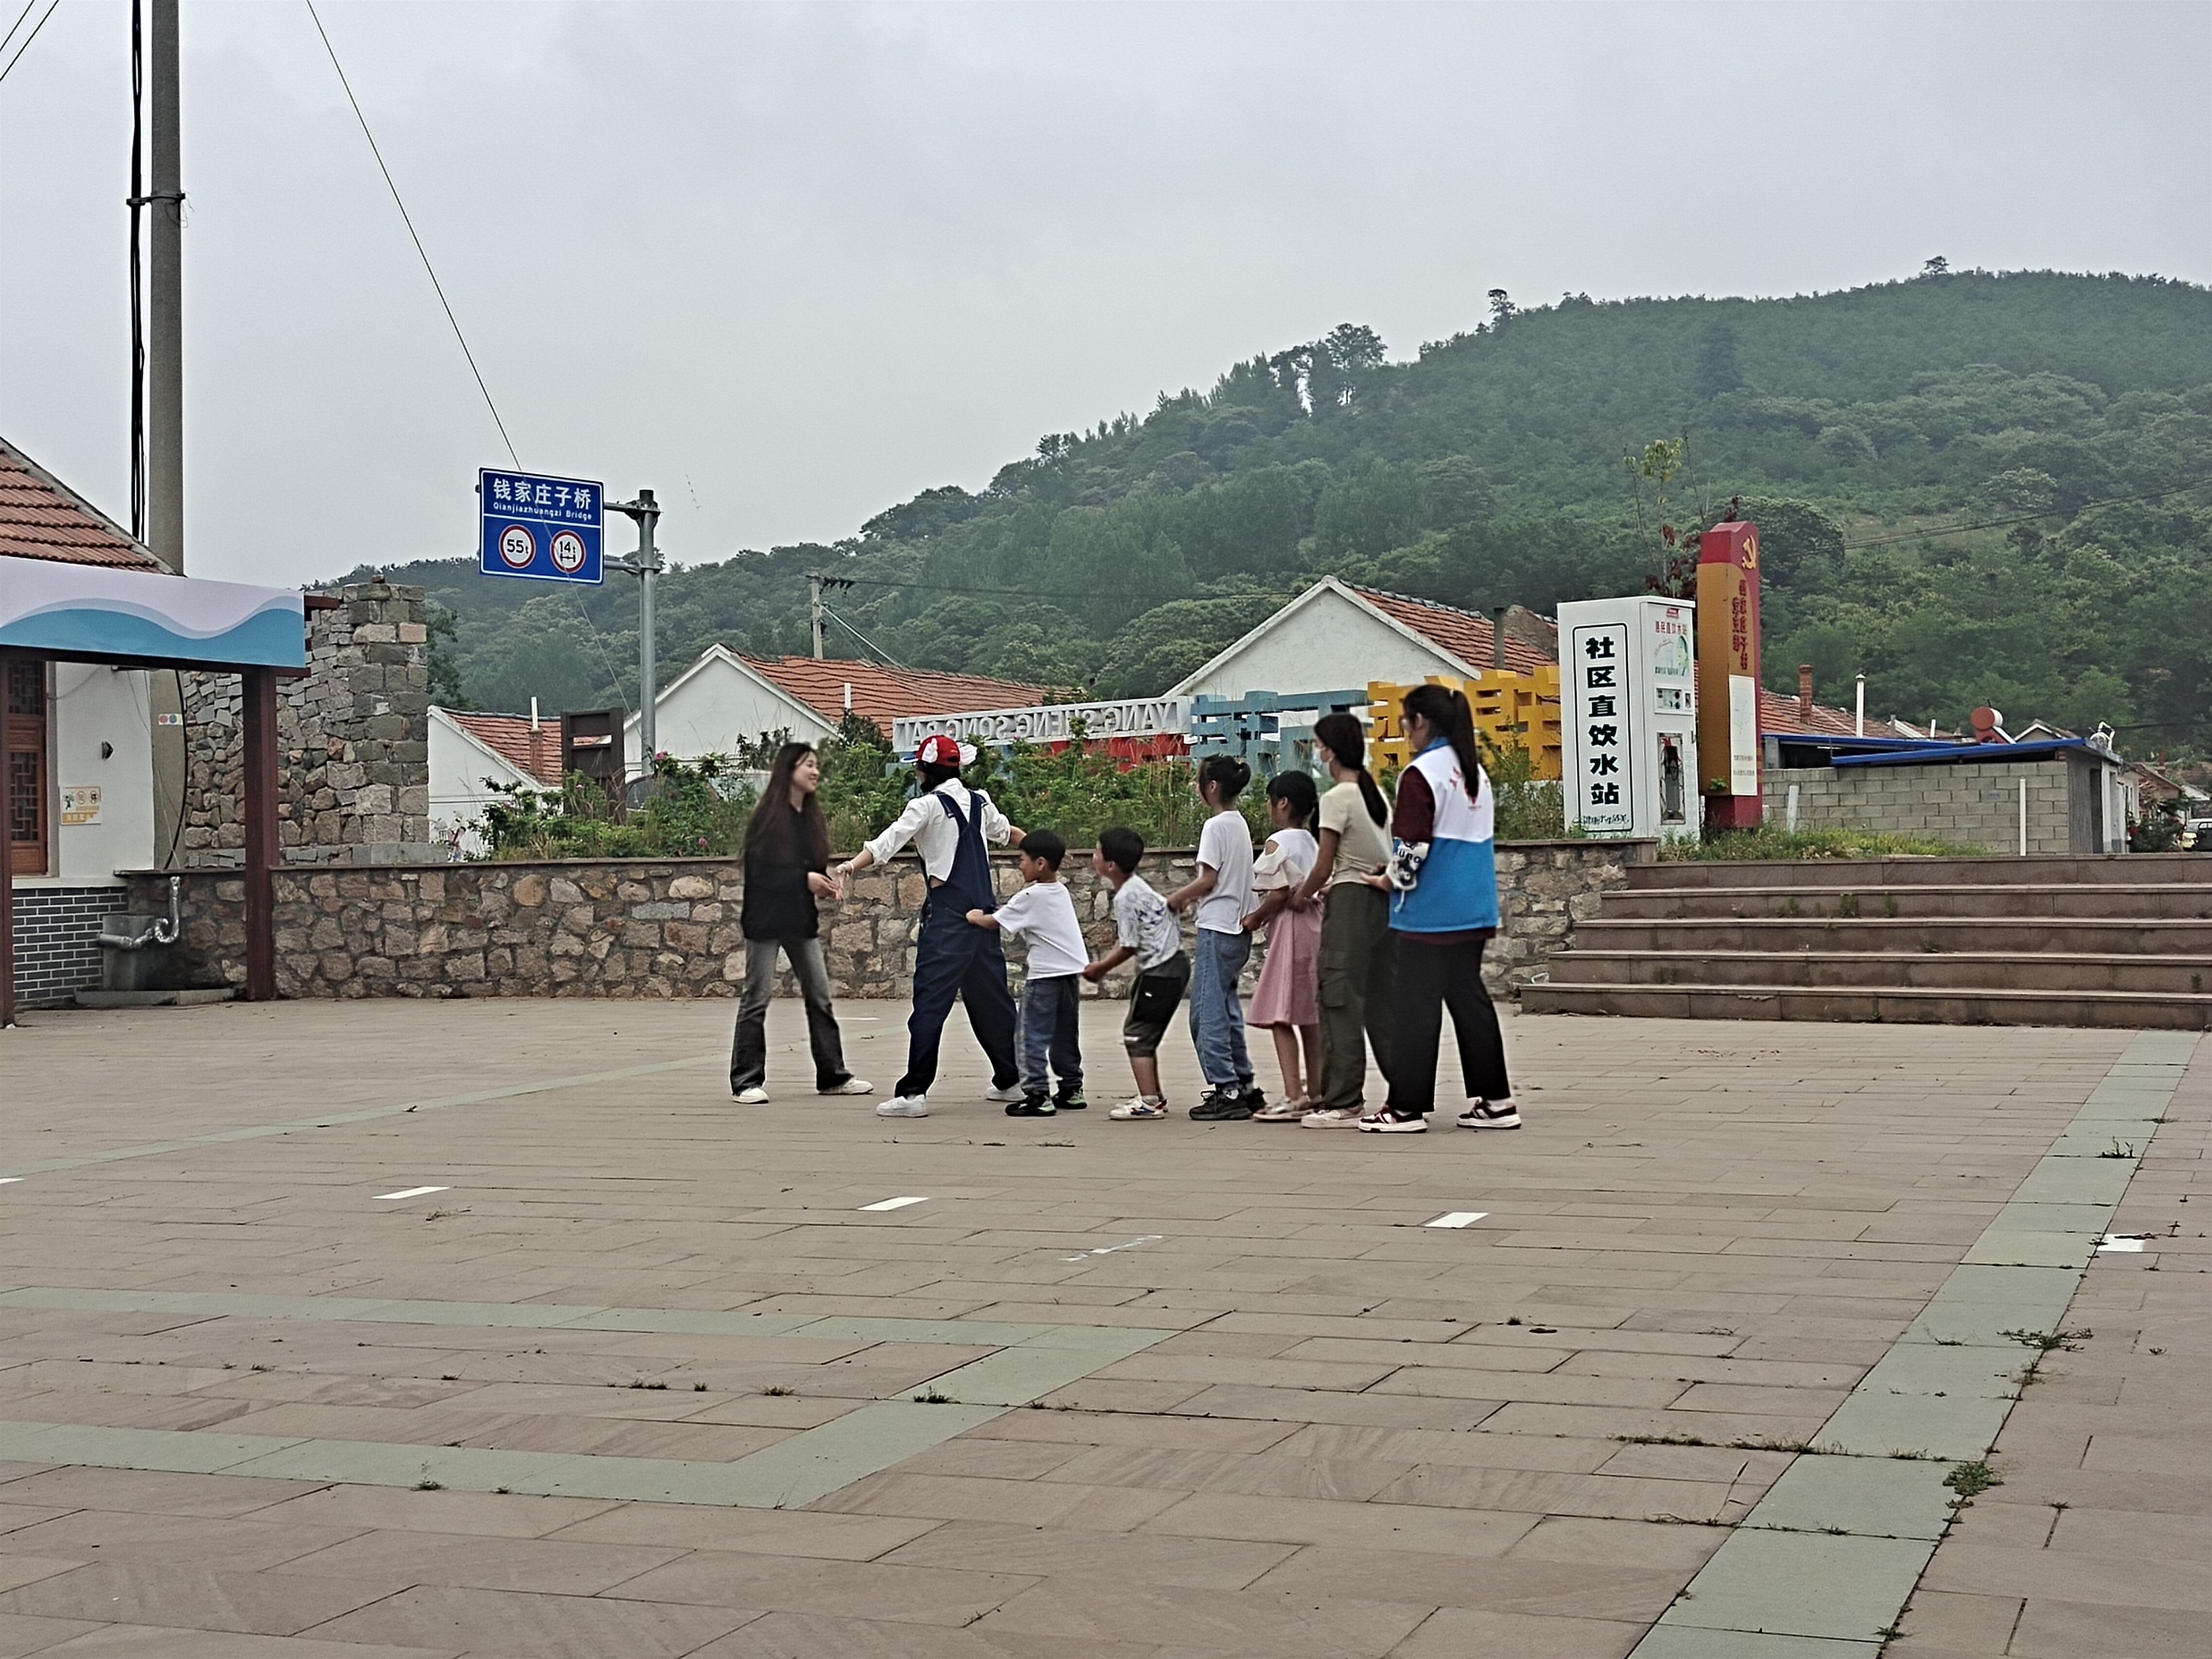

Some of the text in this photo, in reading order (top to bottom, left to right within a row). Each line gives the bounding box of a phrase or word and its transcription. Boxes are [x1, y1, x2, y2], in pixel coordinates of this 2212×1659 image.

[493, 477, 592, 510] 钱家庄子桥
[566, 510, 592, 521] Bridge
[1585, 636, 1619, 805] 社区直饮水站
